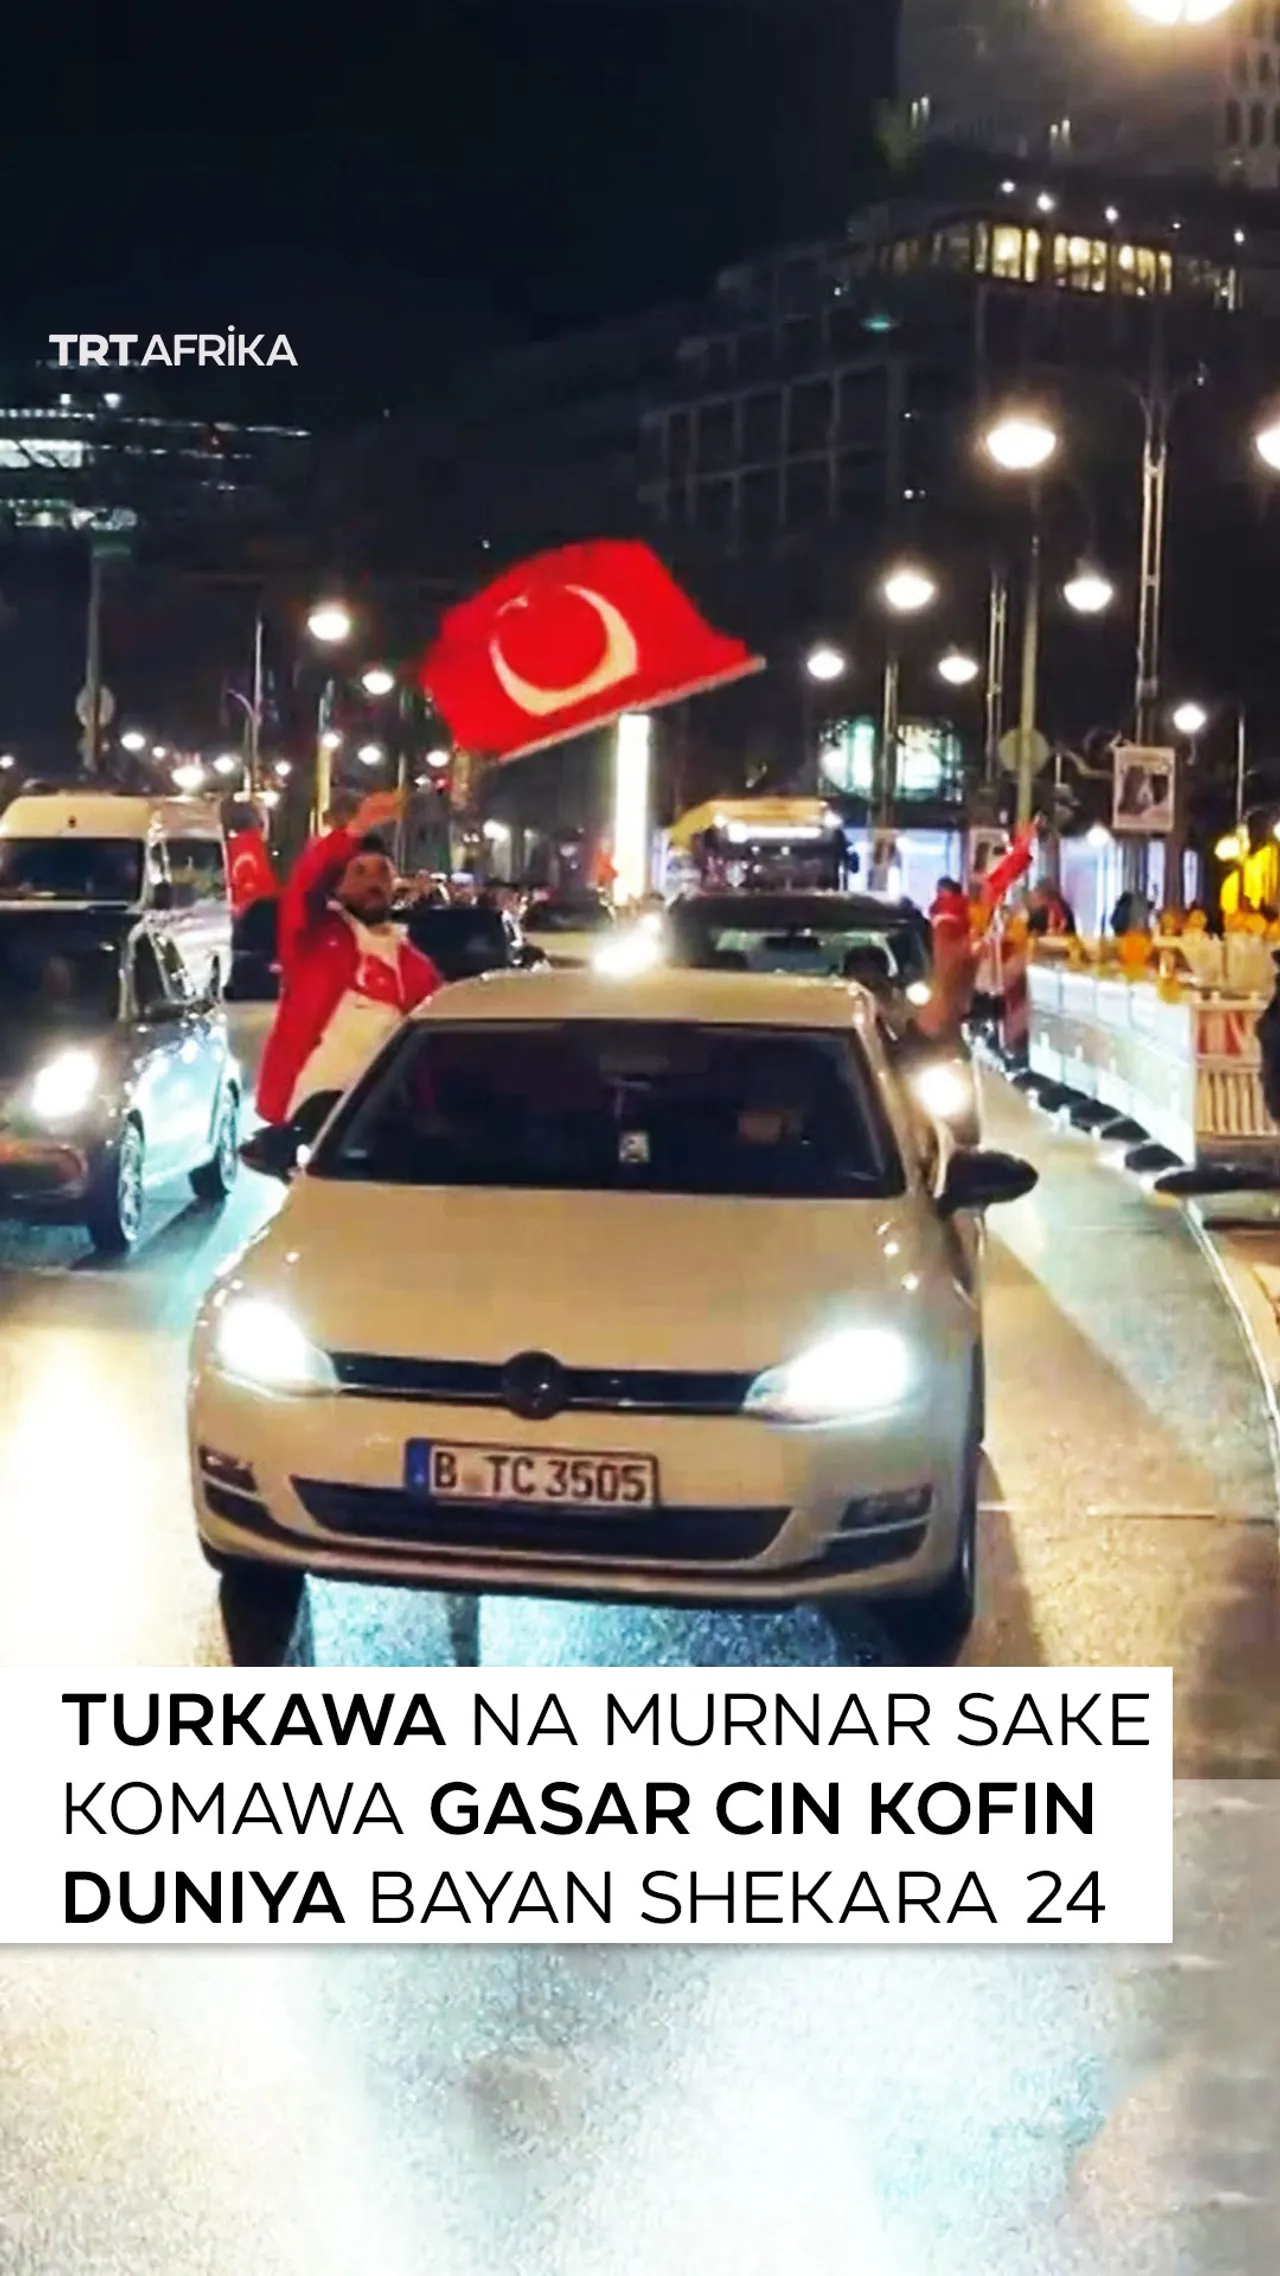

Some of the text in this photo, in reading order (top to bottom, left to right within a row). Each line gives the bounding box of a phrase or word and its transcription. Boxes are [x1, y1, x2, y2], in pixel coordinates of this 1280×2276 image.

[433, 1451, 647, 1503] B TC 3505
